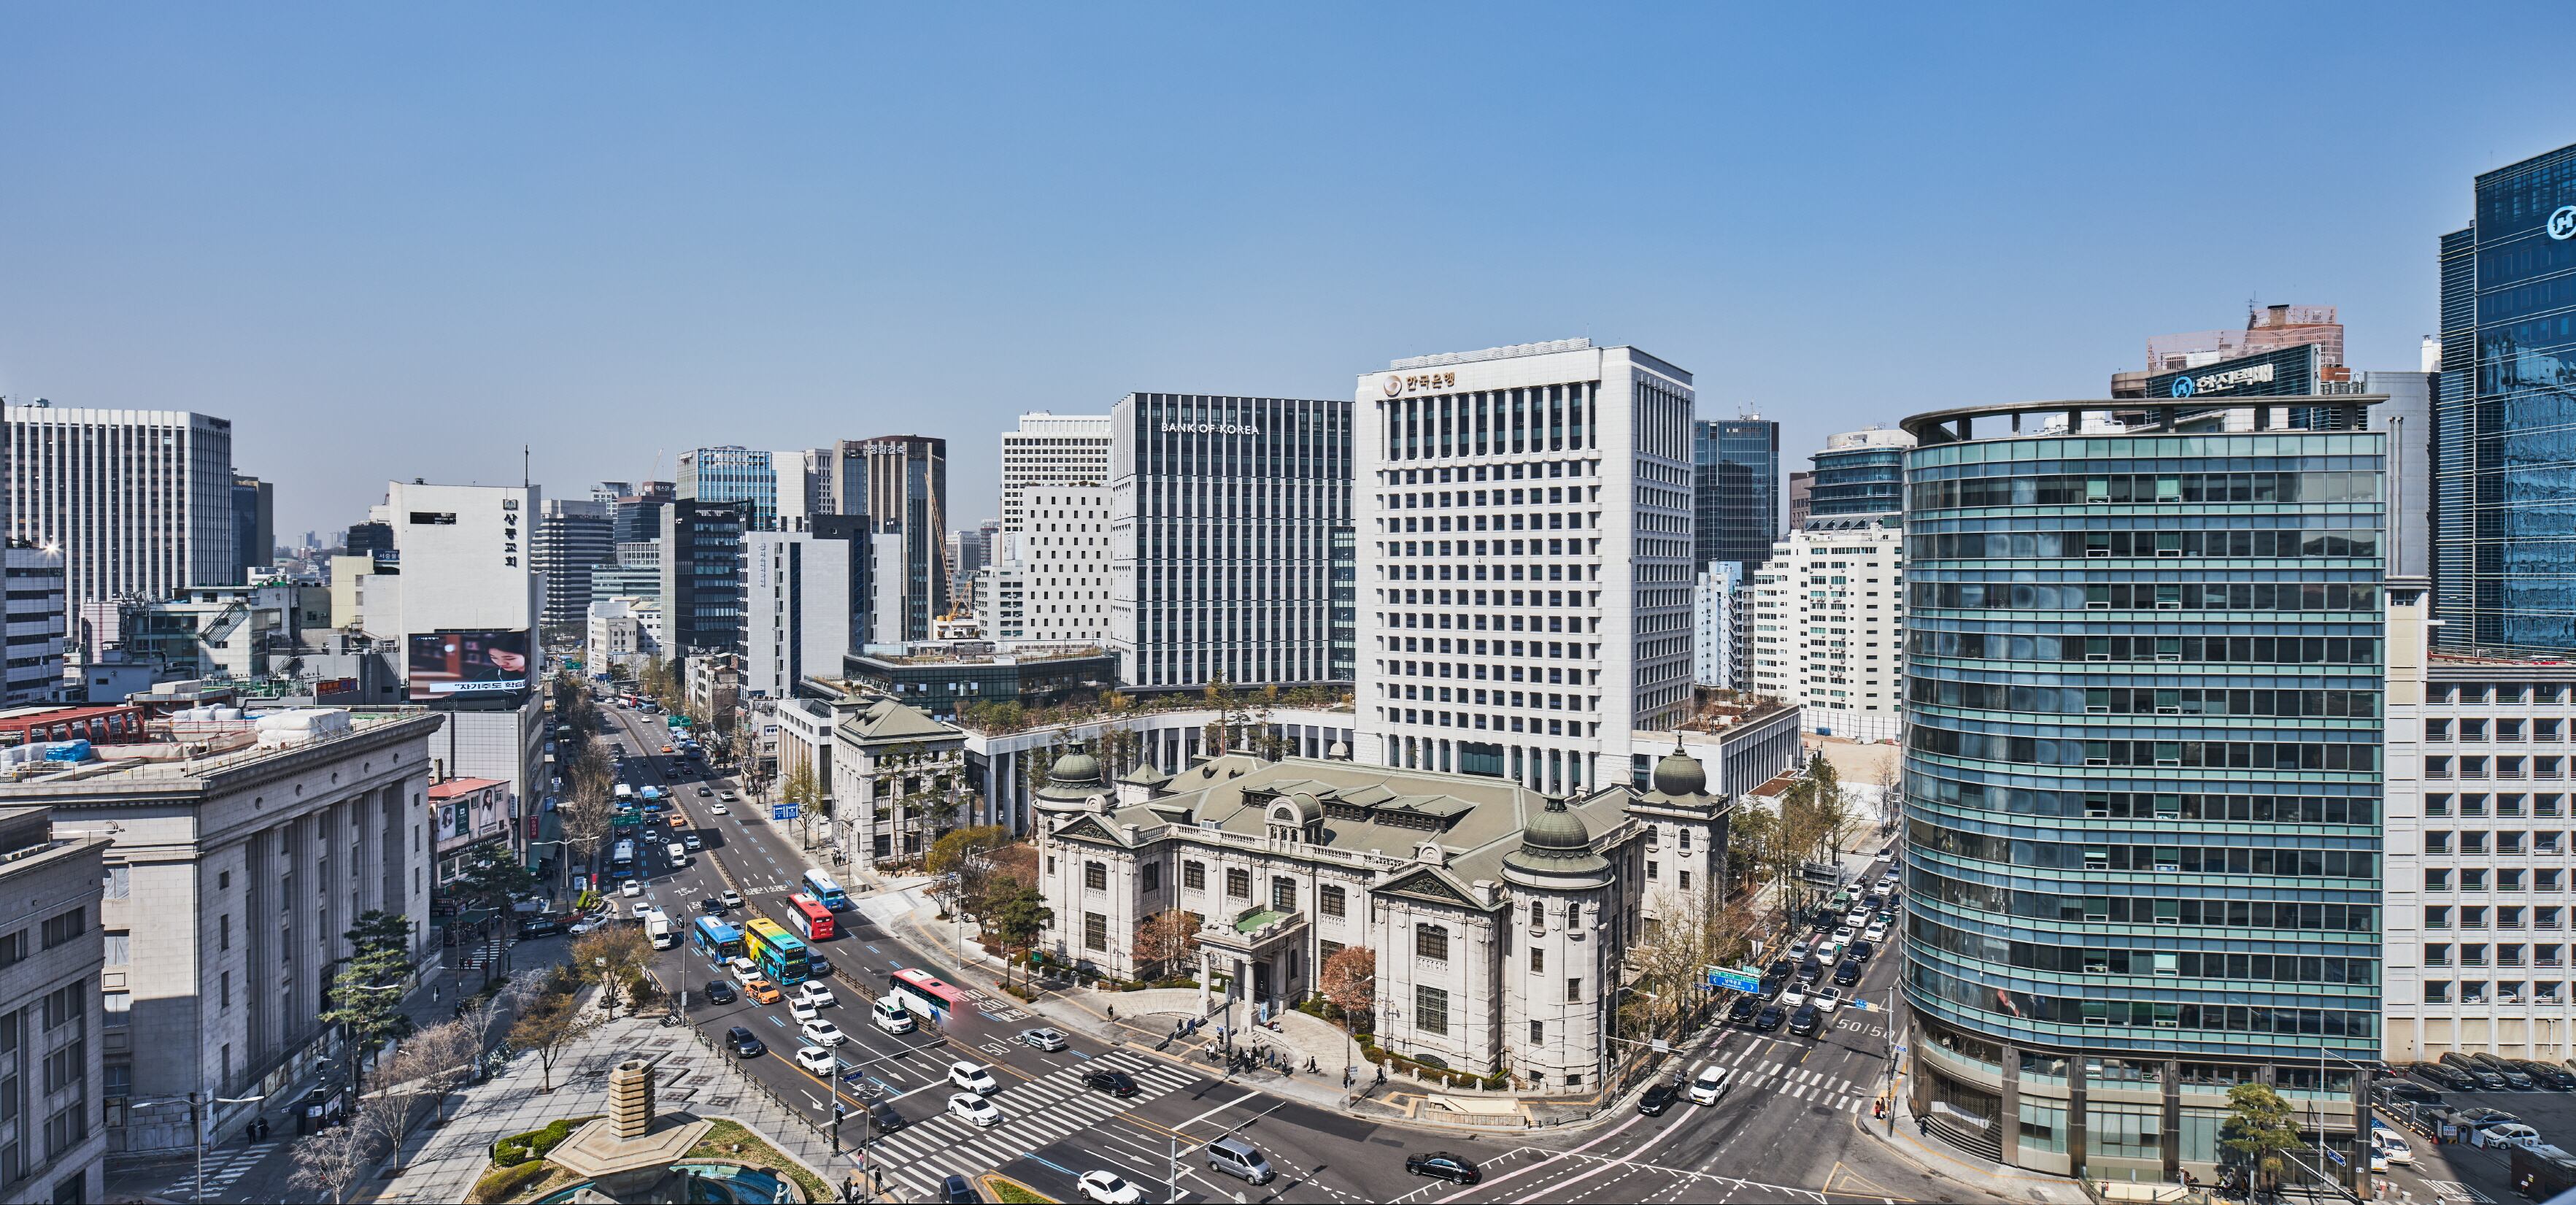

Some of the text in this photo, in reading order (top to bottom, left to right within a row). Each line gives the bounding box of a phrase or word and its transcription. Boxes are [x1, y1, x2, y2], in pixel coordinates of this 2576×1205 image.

[1406, 372, 1454, 392] 한국은행
[2196, 363, 2274, 393] 한진택배
[1161, 423, 1260, 435] BANK OF KOREA
[869, 444, 906, 455] 정림건축
[504, 513, 518, 568] 상동교회
[972, 998, 1009, 1012] 21:00
[1836, 1019, 1862, 1032] 50
[979, 1042, 1011, 1056] 50
